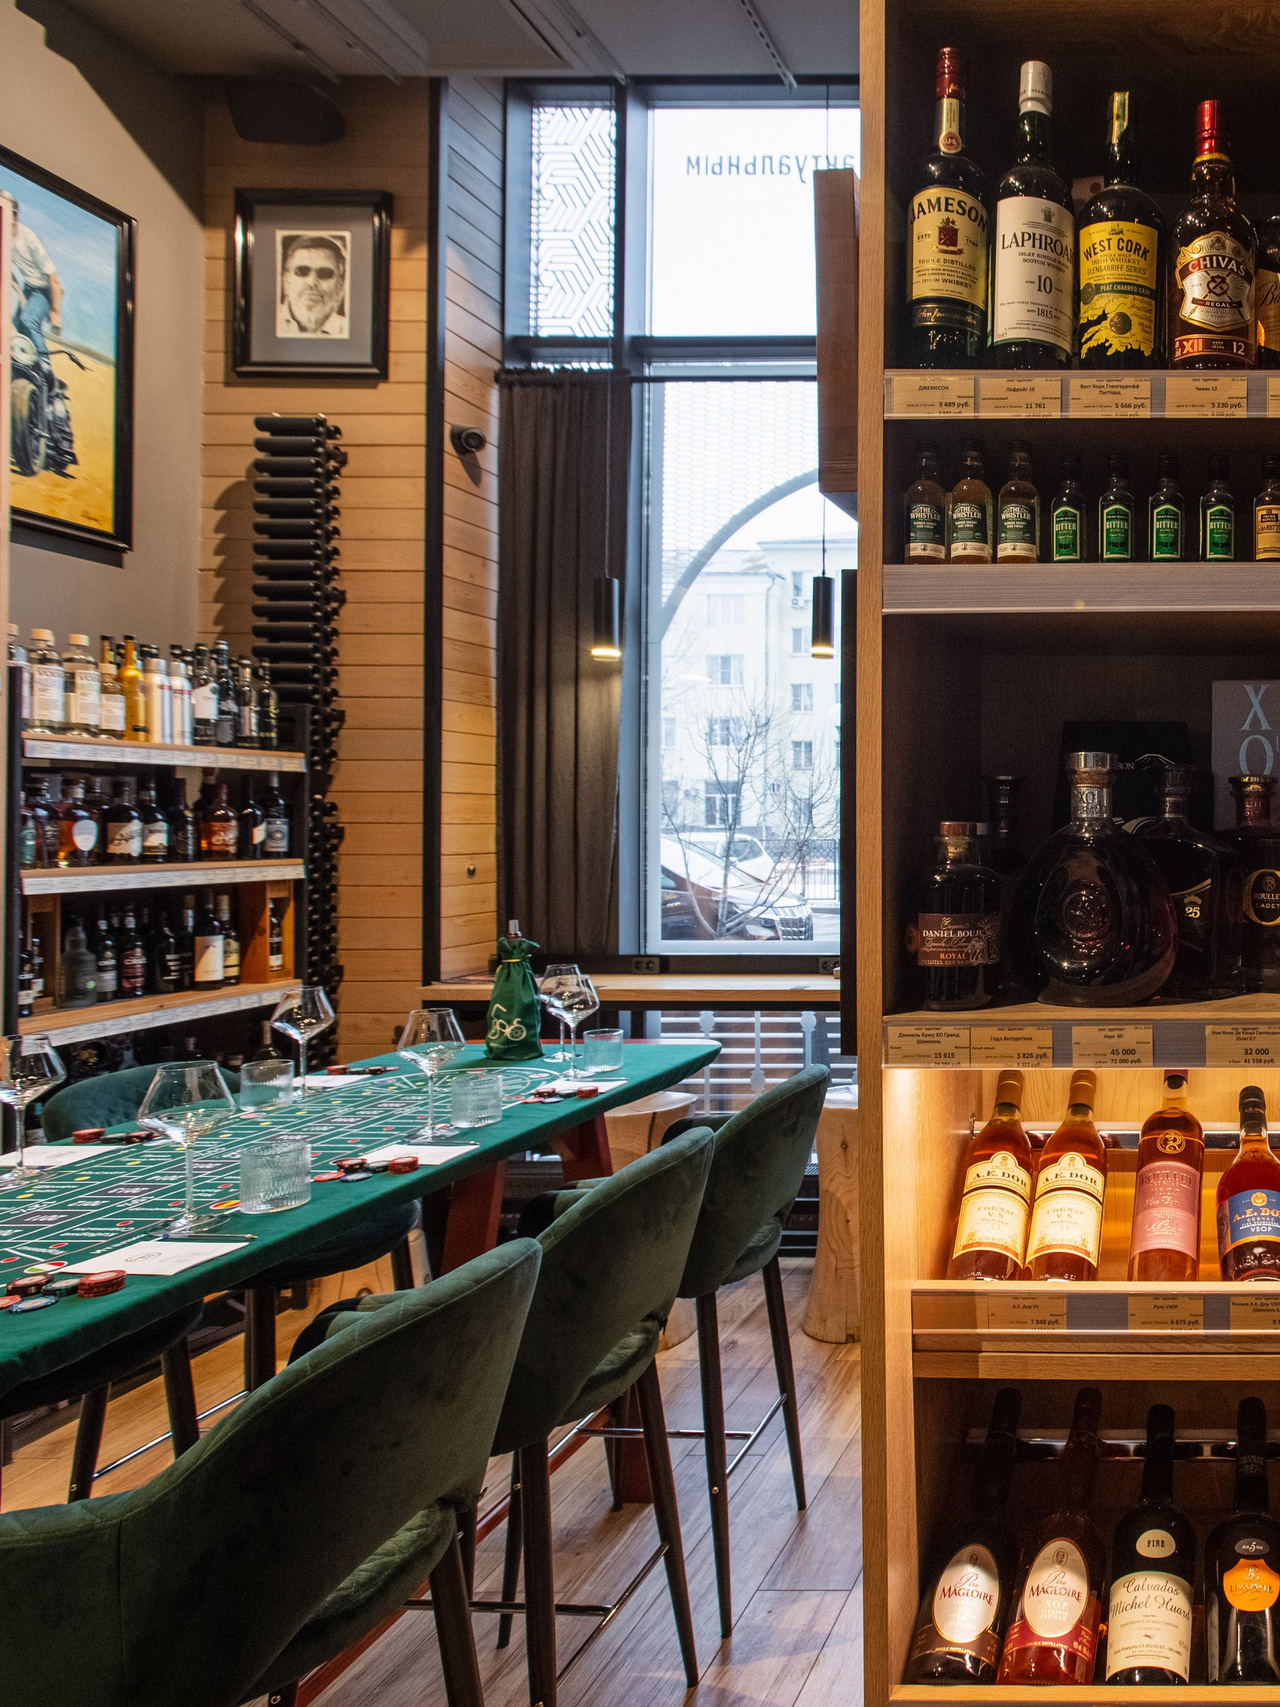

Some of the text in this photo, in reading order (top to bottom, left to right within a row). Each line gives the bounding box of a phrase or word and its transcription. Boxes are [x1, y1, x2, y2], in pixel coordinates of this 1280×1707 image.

[910, 196, 988, 233] JAMESON
[1083, 238, 1150, 261] WEST CORK
[1126, 265, 1146, 276] SERIES
[1188, 256, 1246, 277] CHIVAS
[1037, 275, 1053, 294] 10
[1100, 284, 1137, 293] PEAT CHARRED
[1037, 309, 1053, 319] 1815
[1183, 339, 1245, 355] XII 12
[910, 512, 941, 521] WHISTLER
[1001, 512, 1031, 520] WHISTLER
[1055, 521, 1076, 530] BITTER
[1105, 521, 1128, 529] BITTER
[1156, 521, 1178, 529] BITTER
[1185, 906, 1200, 918] 25
[1002, 1171, 1027, 1188] DOR
[1070, 1172, 1097, 1186] DOR
[1233, 1208, 1258, 1222] A.E.
[1147, 1539, 1165, 1547] FINE
[1248, 1542, 1256, 1553] 5
[1028, 1584, 1082, 1603] MAGLOIRE
[1123, 1578, 1181, 1596] Calvados
[939, 1586, 994, 1606] MAGLOIRE
[1111, 1596, 1152, 1619] Michel
